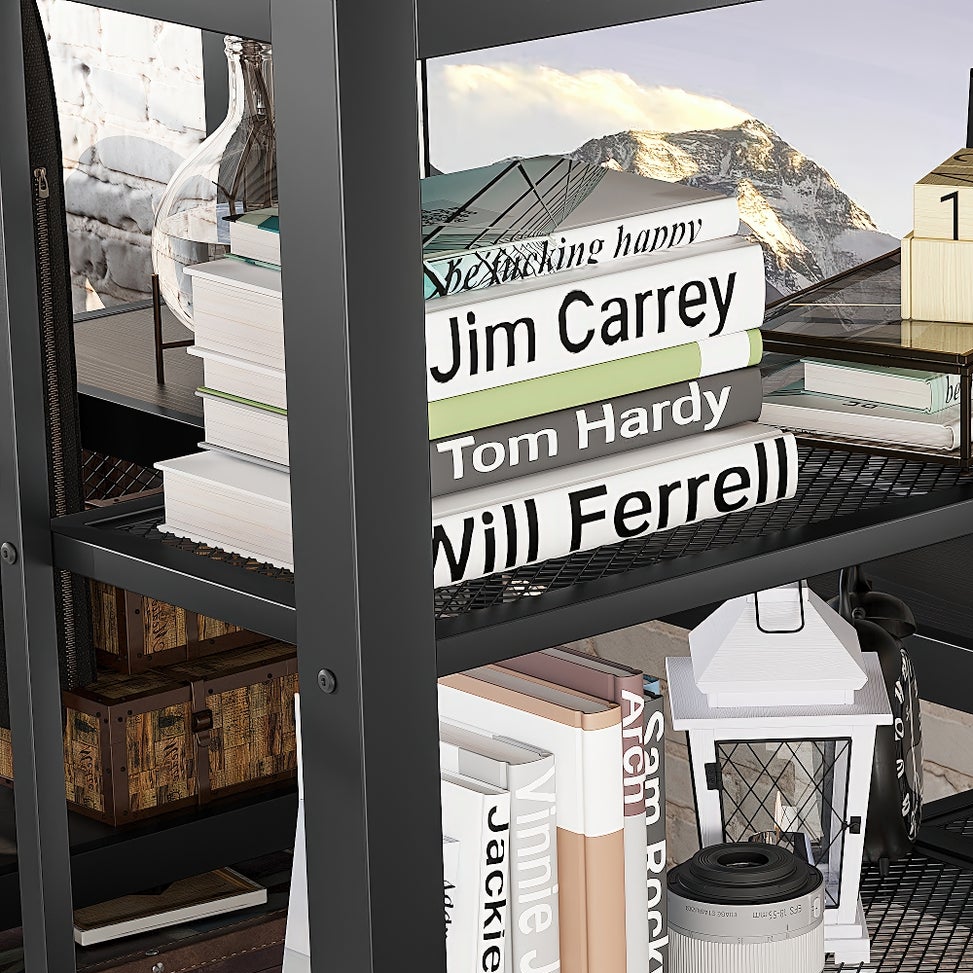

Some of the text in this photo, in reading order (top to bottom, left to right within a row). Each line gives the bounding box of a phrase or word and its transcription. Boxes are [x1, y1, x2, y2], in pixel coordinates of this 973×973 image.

[613, 218, 703, 259] happy
[940, 190, 959, 240] 1
[430, 272, 737, 384] Jim Carrey
[437, 381, 732, 480] Tom Hardy
[569, 438, 788, 552] Ferrell
[621, 690, 645, 805] Arch
[482, 804, 510, 973] Jackie
[515, 765, 556, 935] Vinnie
